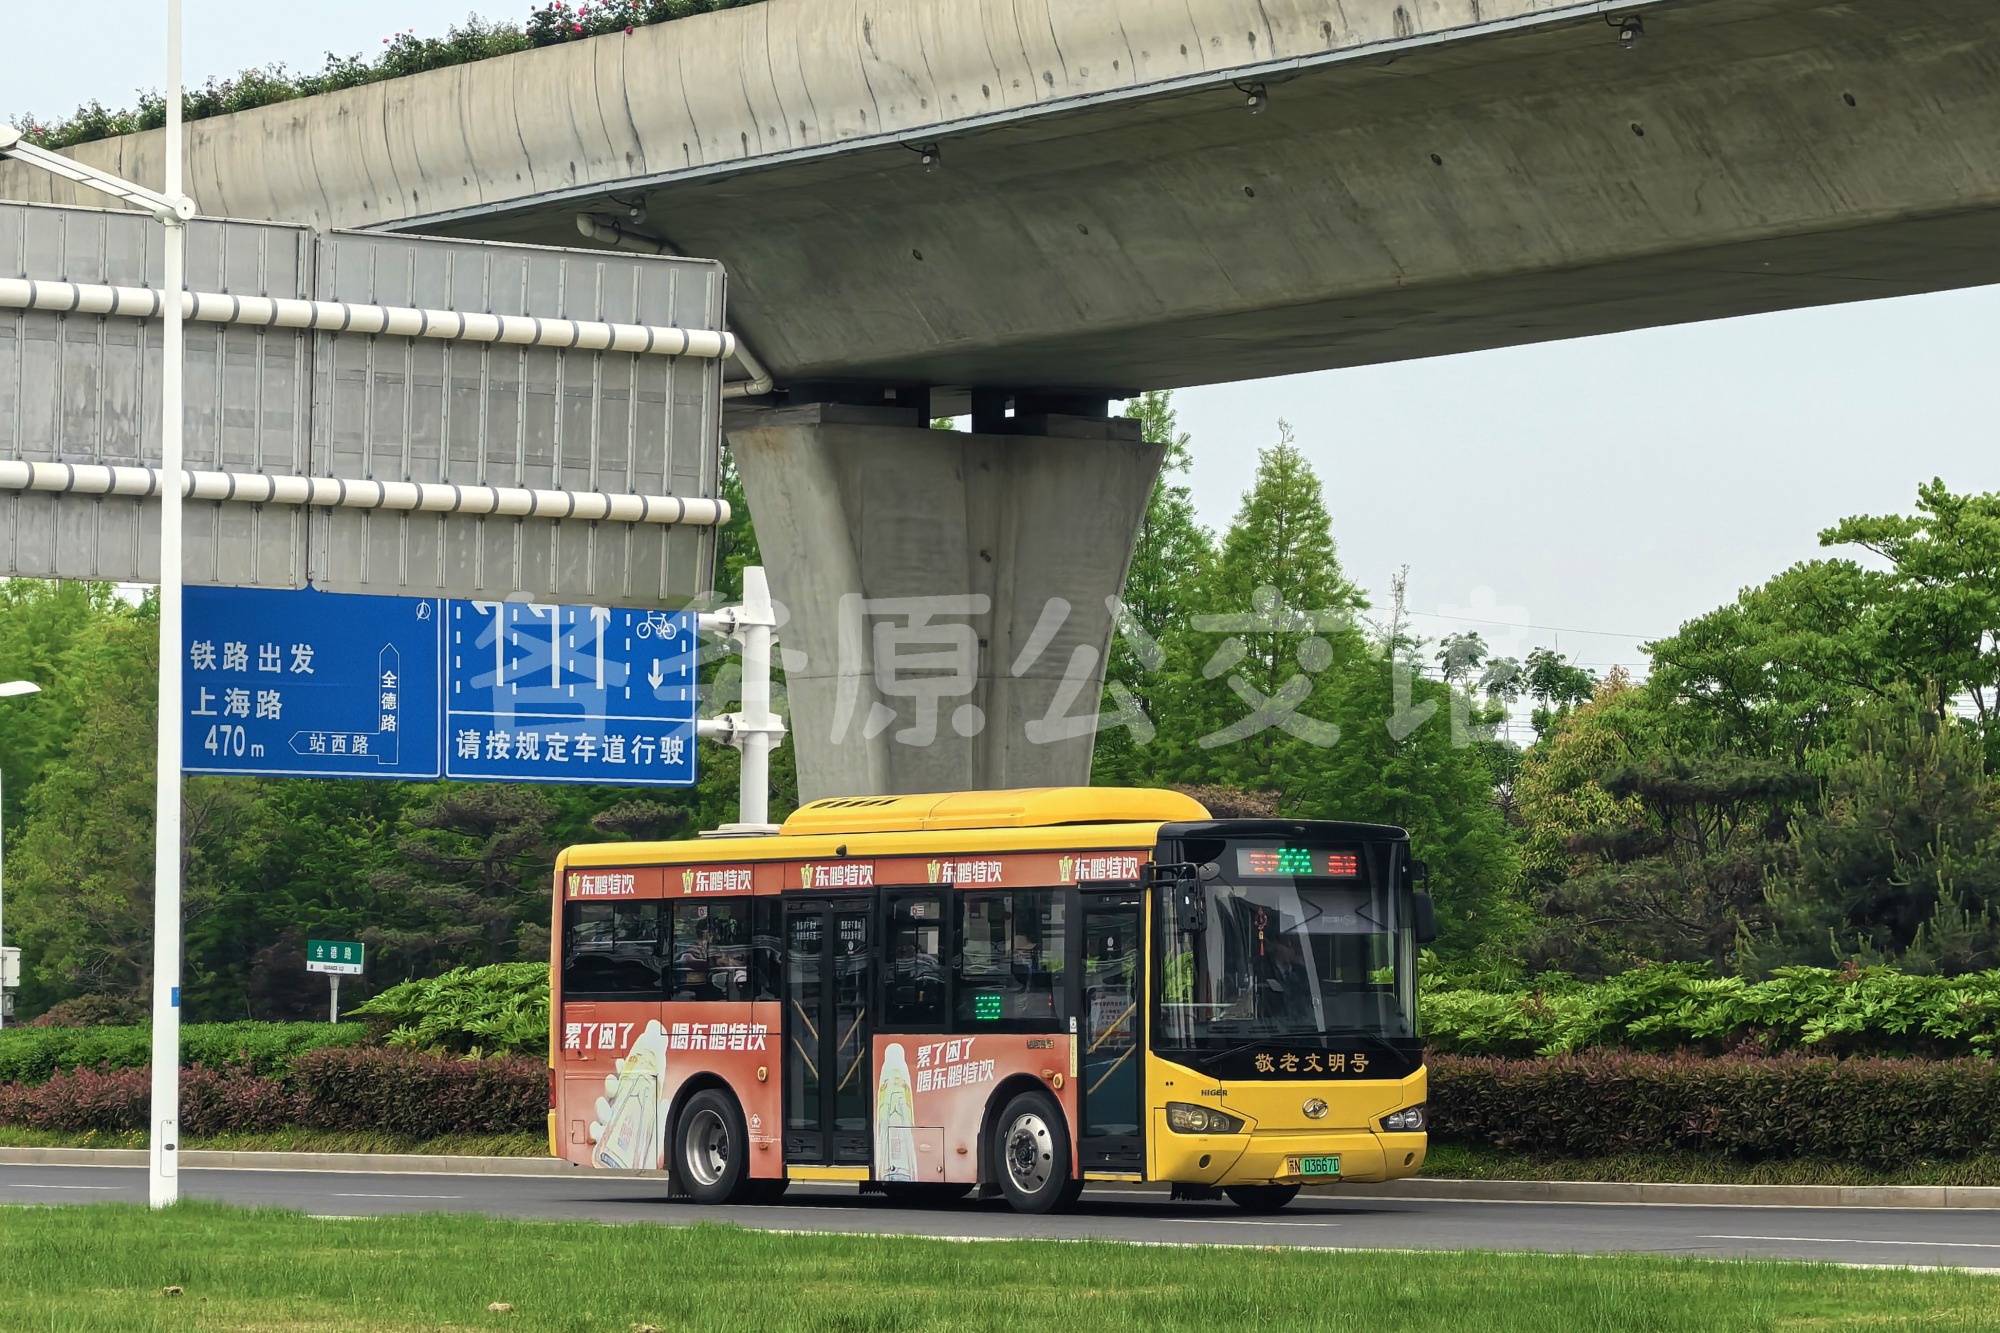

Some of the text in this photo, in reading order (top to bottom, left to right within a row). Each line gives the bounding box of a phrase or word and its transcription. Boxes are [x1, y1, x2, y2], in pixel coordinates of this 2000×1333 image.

[190, 640, 315, 674] 铁路出发
[191, 687, 283, 720] 上海路
[381, 670, 397, 732] 全德路
[204, 725, 264, 757] 470 m
[310, 733, 369, 755] 站西路
[456, 729, 685, 765] 请按规定车道行驶
[696, 869, 751, 892] 东鹏特饮
[815, 864, 873, 887] 东鹏特饮
[942, 861, 1001, 884] 东鹏特饮
[1074, 857, 1138, 880] 东鹏特饮
[581, 874, 634, 895] 东鹏特饮
[564, 1022, 767, 1050] 累了困了 喝东鹏特饮
[916, 1037, 976, 1068] 累了困了
[1254, 1053, 1369, 1073] 敬老文明号
[916, 1059, 995, 1092] 喝东鹏特饮
[1201, 1089, 1228, 1097] HIGER
